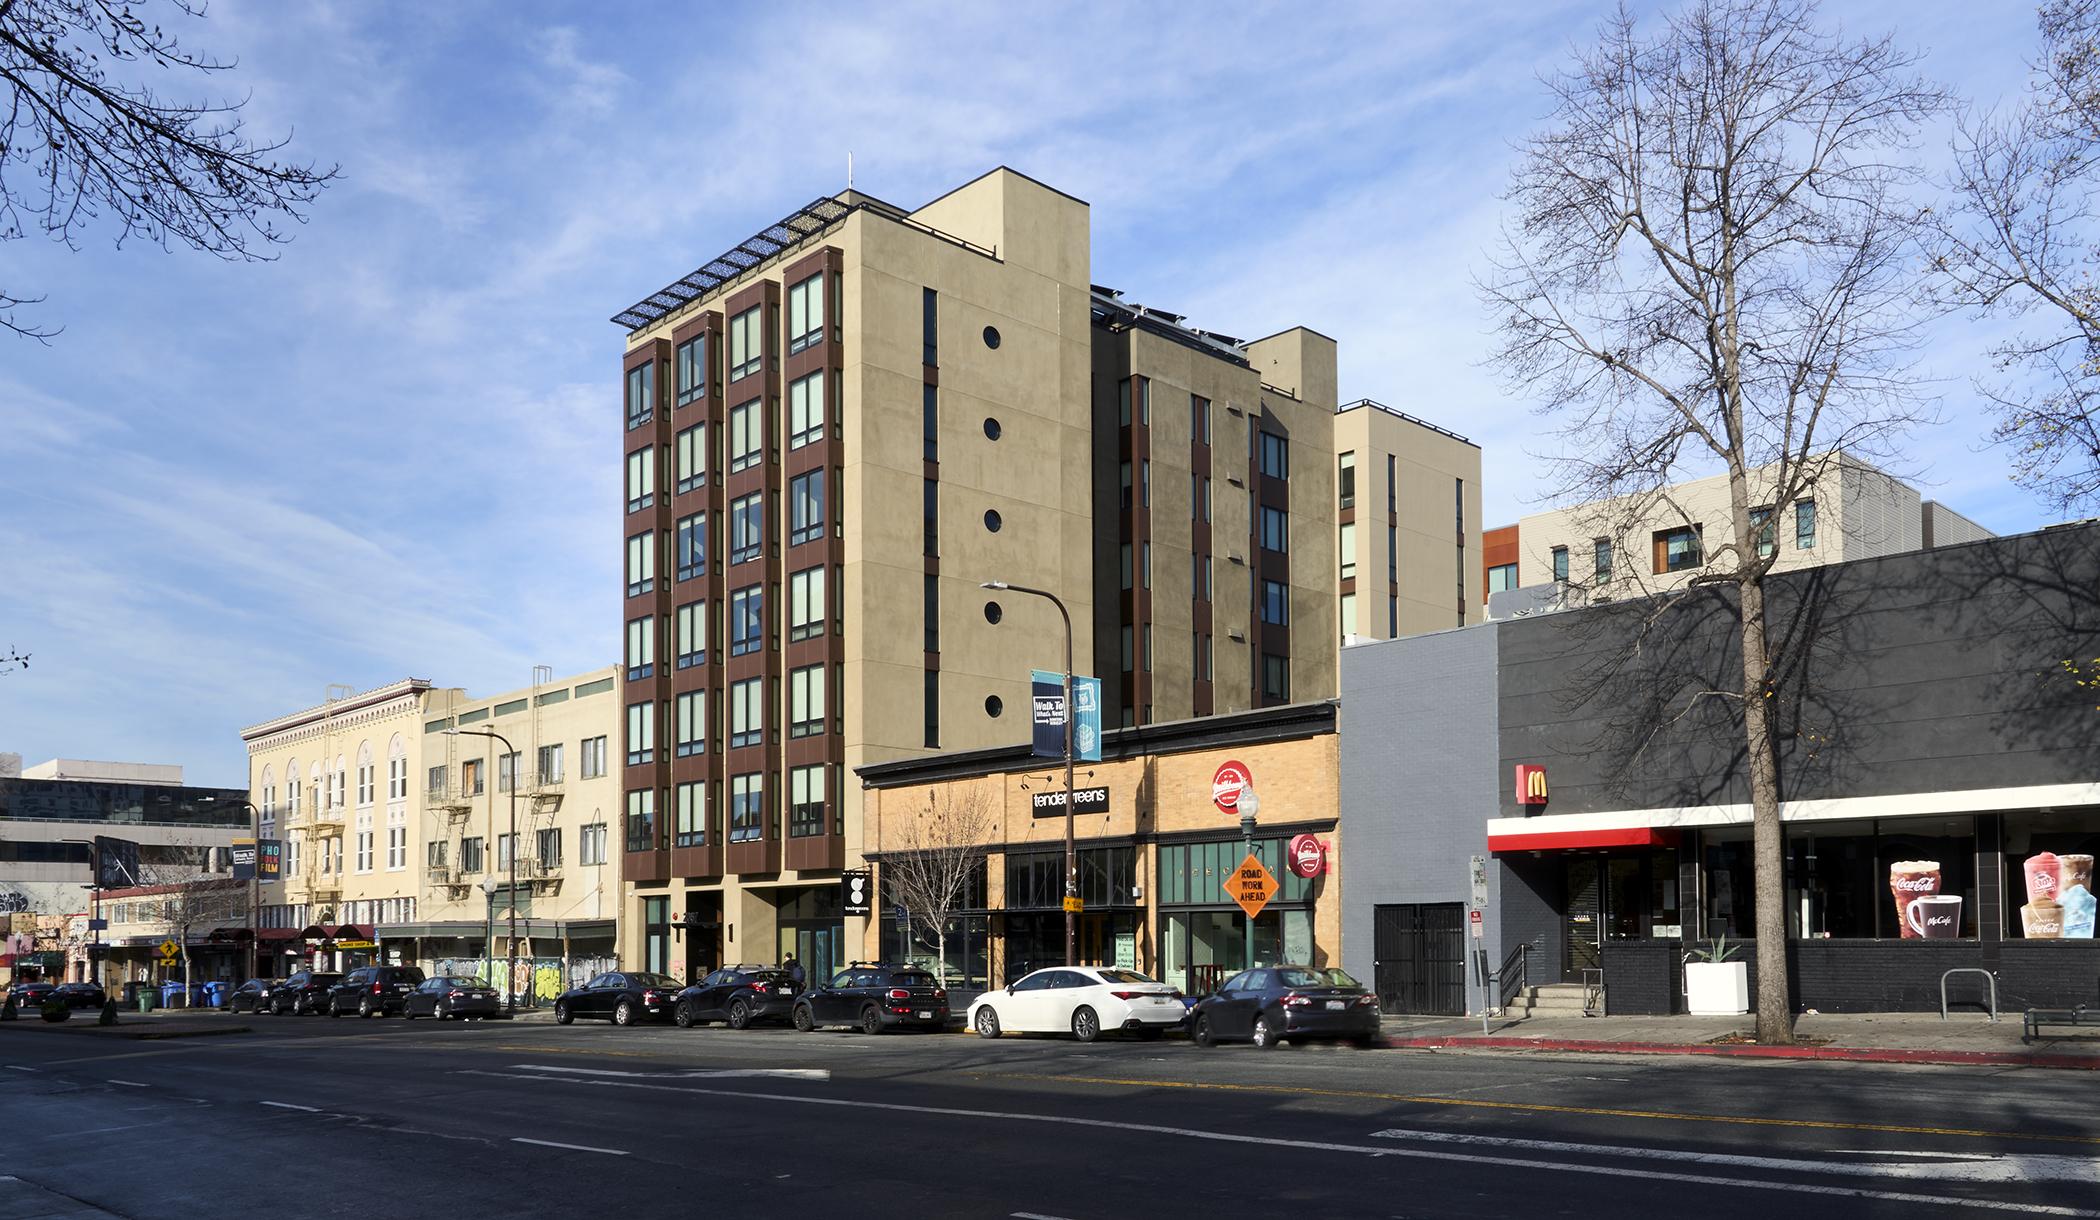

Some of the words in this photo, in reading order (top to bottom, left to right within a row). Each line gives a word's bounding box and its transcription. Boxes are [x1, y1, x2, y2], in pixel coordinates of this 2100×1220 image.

[1035, 701, 1054, 711] Walk
[1055, 701, 1063, 710] To
[1033, 789, 1106, 808] tenderreens
[261, 846, 279, 855] PHO
[261, 864, 278, 872] FILM
[1241, 869, 1262, 879] ROAD
[1242, 881, 1263, 890] WORK
[1896, 877, 1935, 891] Coca-Cola
[1240, 892, 1266, 901] AHEAD
